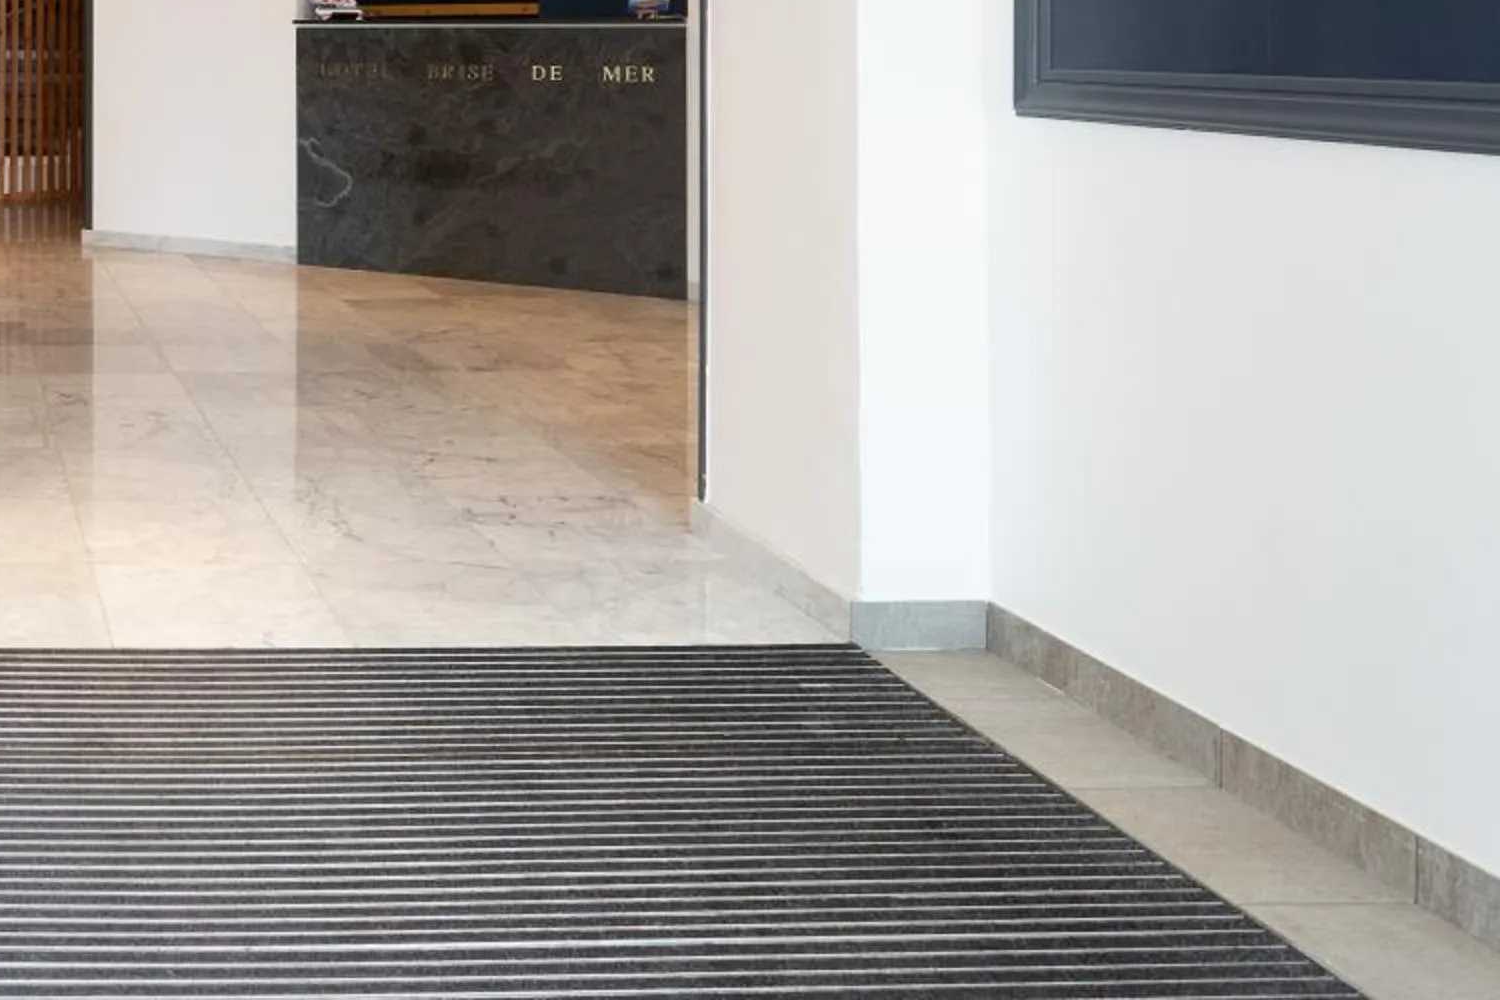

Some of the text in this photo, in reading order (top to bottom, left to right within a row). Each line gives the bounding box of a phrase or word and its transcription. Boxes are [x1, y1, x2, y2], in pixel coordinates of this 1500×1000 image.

[427, 63, 495, 81] BRISE
[531, 64, 564, 82] DE
[602, 65, 656, 84] MER
